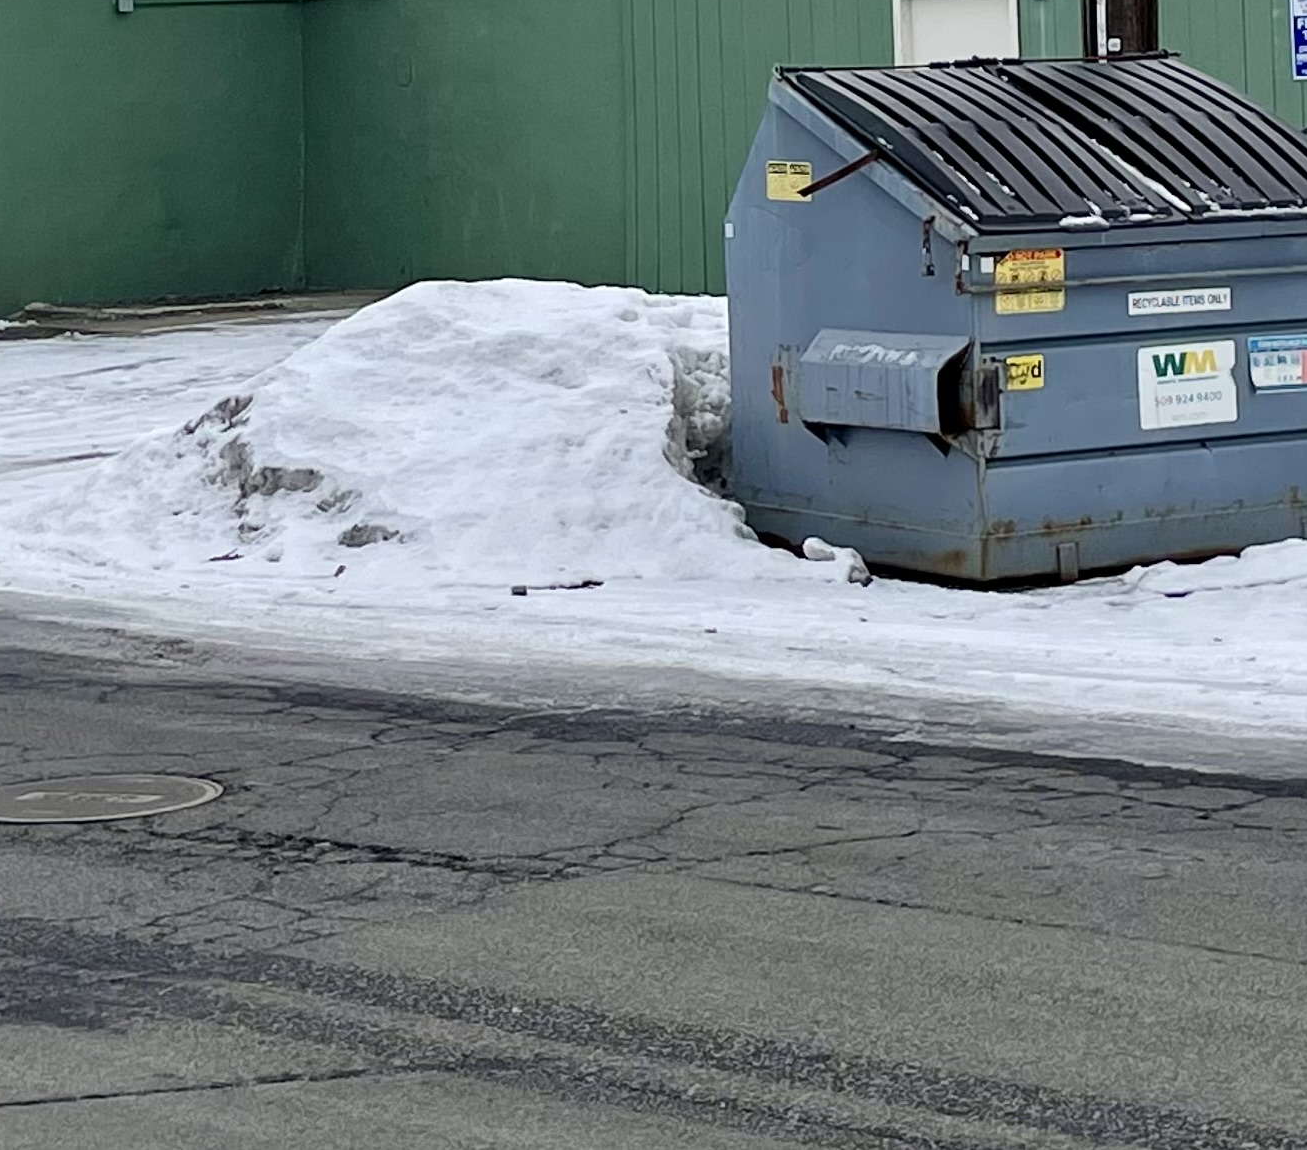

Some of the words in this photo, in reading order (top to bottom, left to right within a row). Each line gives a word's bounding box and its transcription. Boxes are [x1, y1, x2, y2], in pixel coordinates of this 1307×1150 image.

[1133, 296, 1180, 309] RECYCLABLE
[1182, 295, 1205, 306] ITEMS
[1207, 293, 1228, 305] ONLY
[1152, 350, 1217, 377] WM
[1175, 393, 1194, 406] 924
